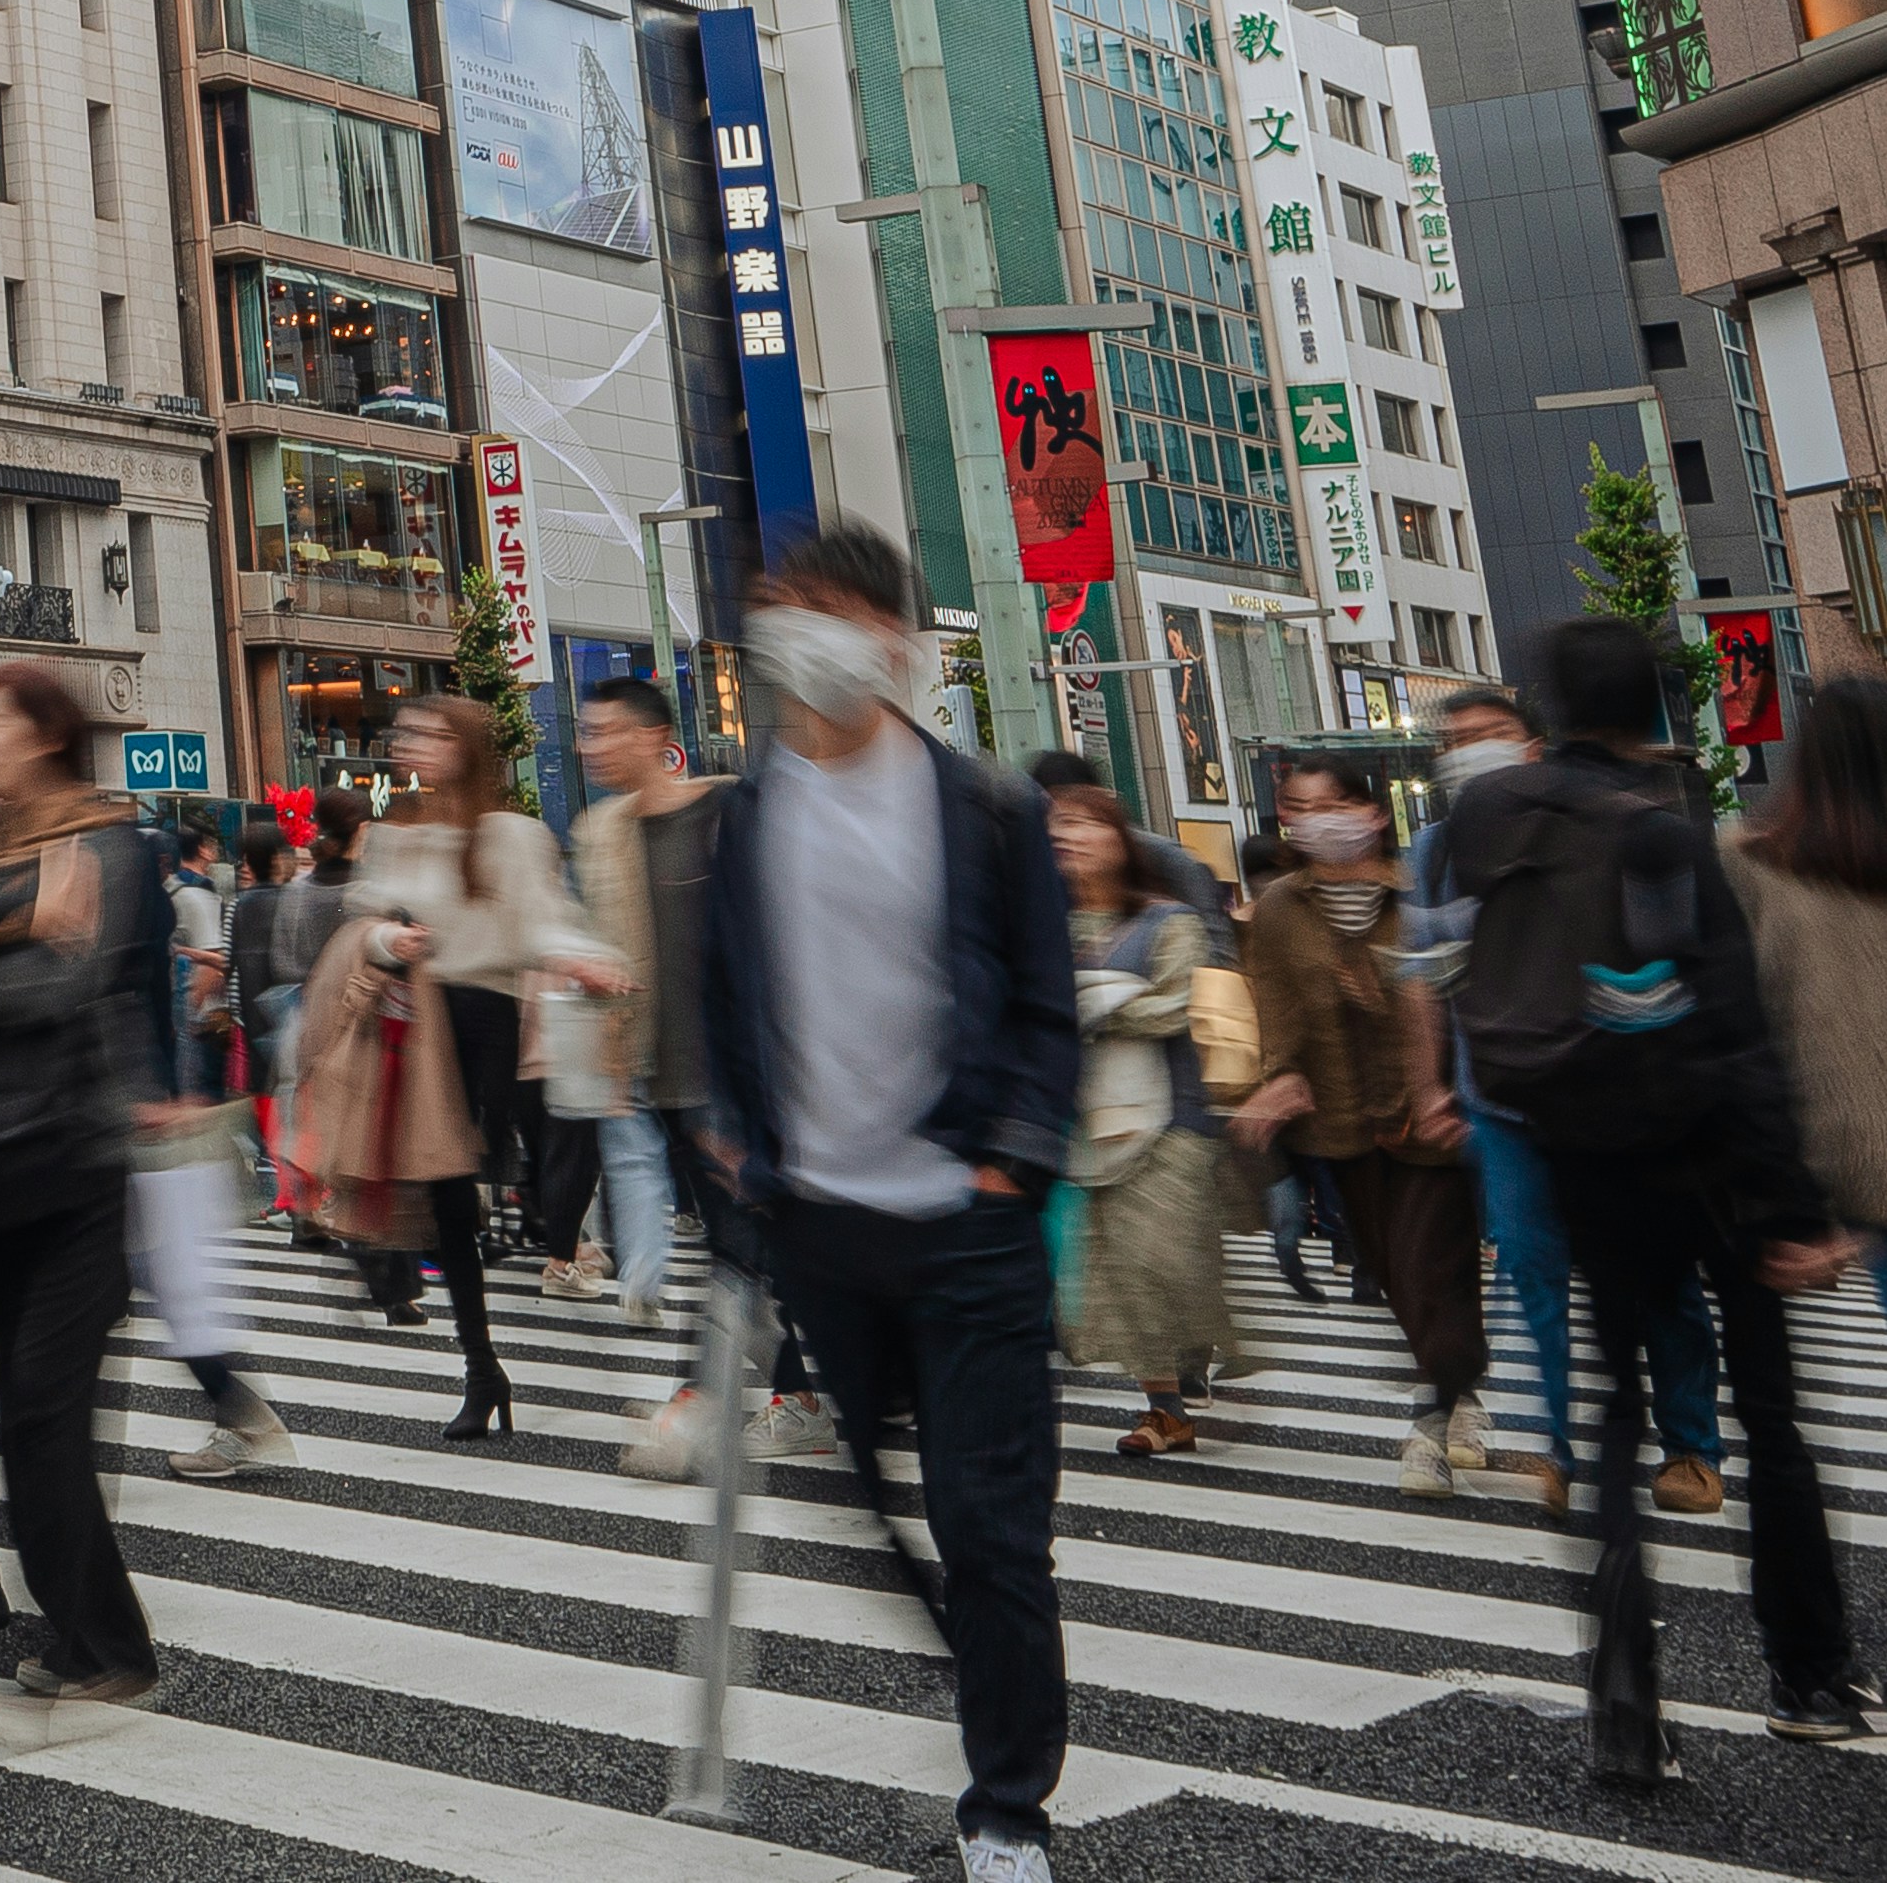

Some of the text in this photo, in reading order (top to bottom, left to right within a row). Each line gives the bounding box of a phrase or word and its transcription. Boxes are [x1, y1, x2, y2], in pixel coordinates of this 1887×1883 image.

[466, 141, 492, 163] KDDI
[488, 110, 511, 126] VISION
[497, 150, 520, 170] au
[1233, 11, 1316, 255] 教文館
[717, 123, 788, 358] 山野楽器
[1406, 150, 1456, 296] 教文館ビル
[1291, 276, 1319, 365] SINCE 1885
[1299, 396, 1349, 454] 本
[1320, 480, 1361, 593] ナルニア国
[1345, 473, 1372, 566] 子どもの本のみせ
